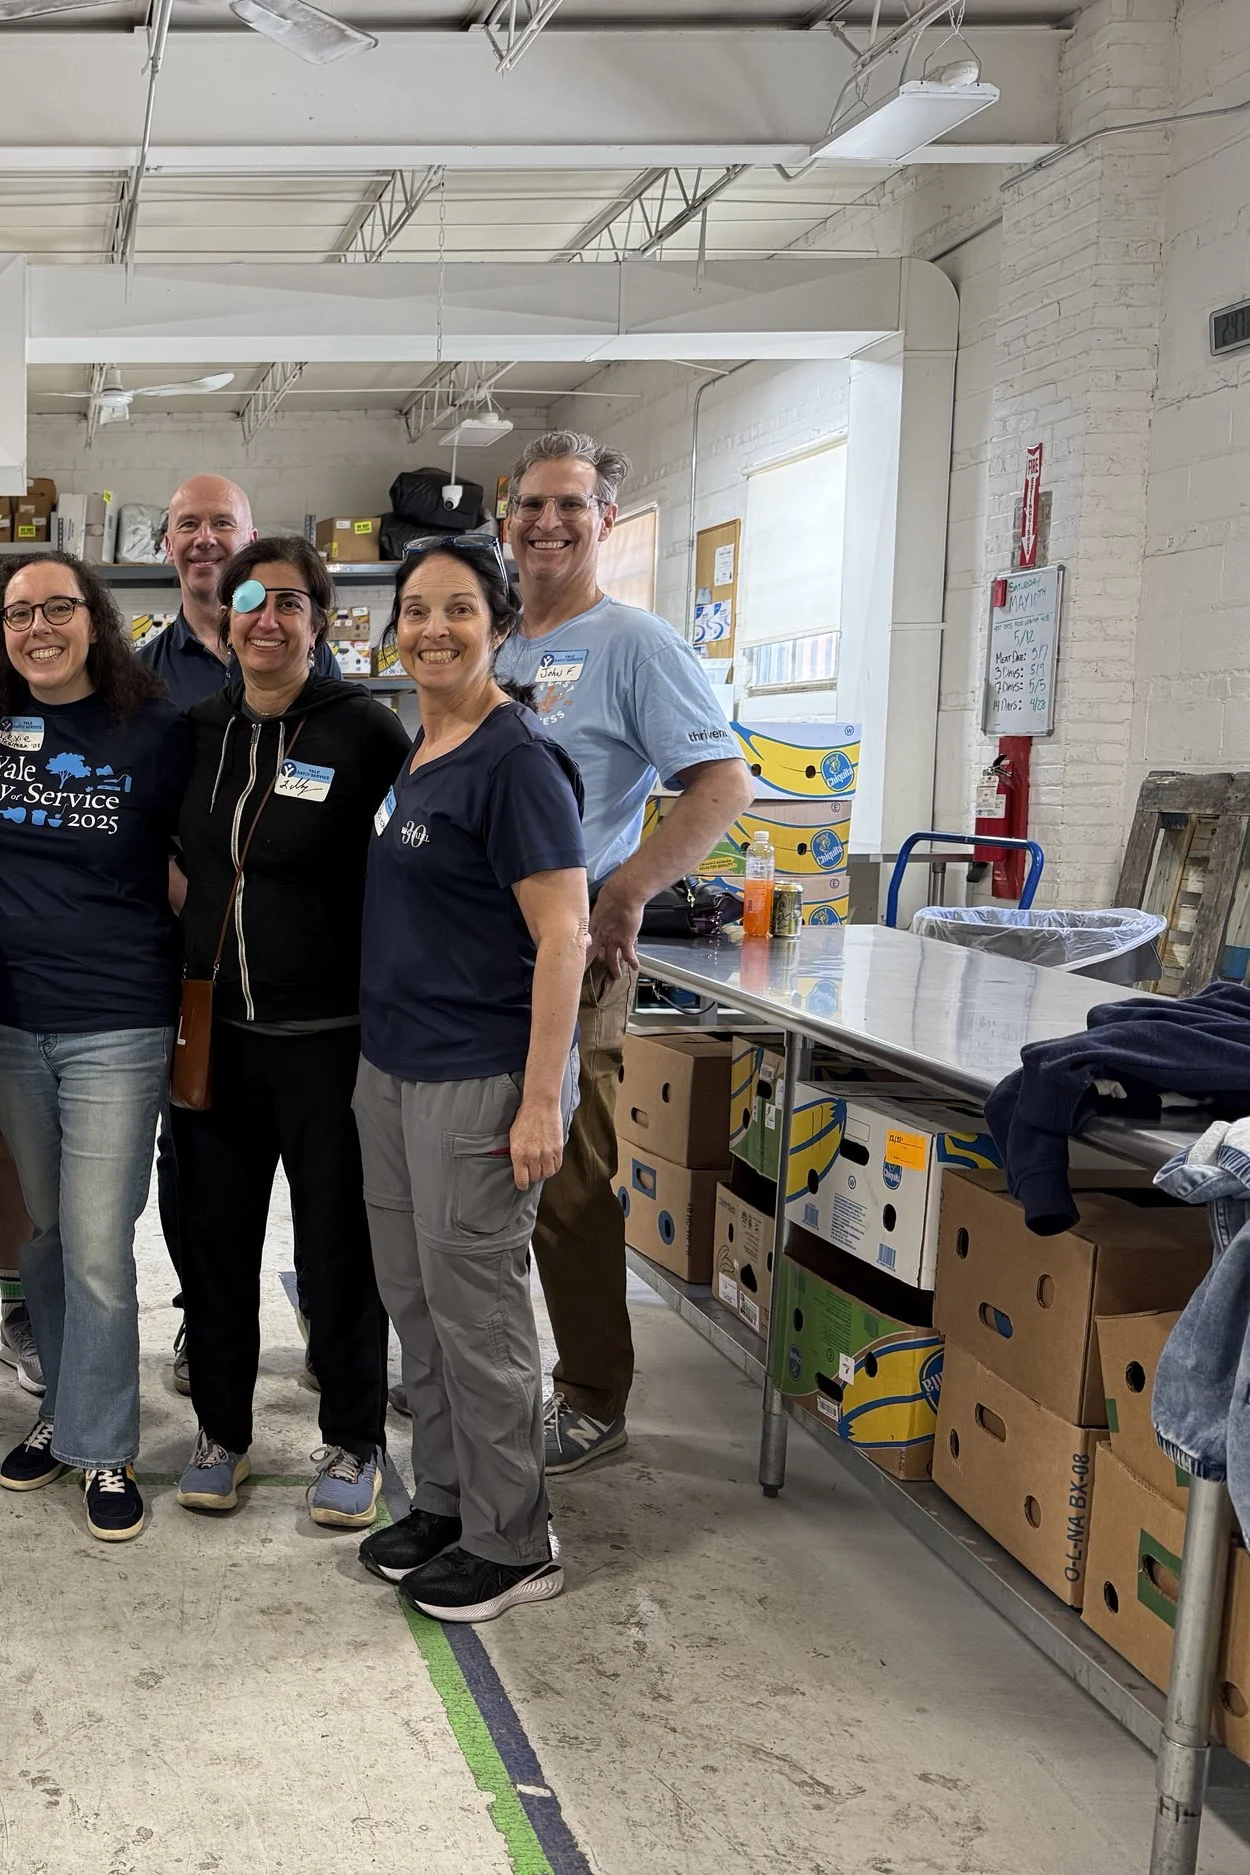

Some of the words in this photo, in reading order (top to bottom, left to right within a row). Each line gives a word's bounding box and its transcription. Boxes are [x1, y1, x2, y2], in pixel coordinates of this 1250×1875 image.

[1014, 629, 1035, 647] 5/12
[994, 666, 1002, 680] 3
[995, 681, 1002, 694] 7
[1029, 678, 1046, 694] 5/5
[826, 767, 853, 788] Chiquita
[10, 793, 23, 801] of
[24, 783, 120, 810] Service
[67, 813, 119, 835] 2025
[816, 844, 843, 865] Chiquita
[1069, 1453, 1091, 1509] BX-08
[1064, 1515, 1086, 1582] O-L-NA
